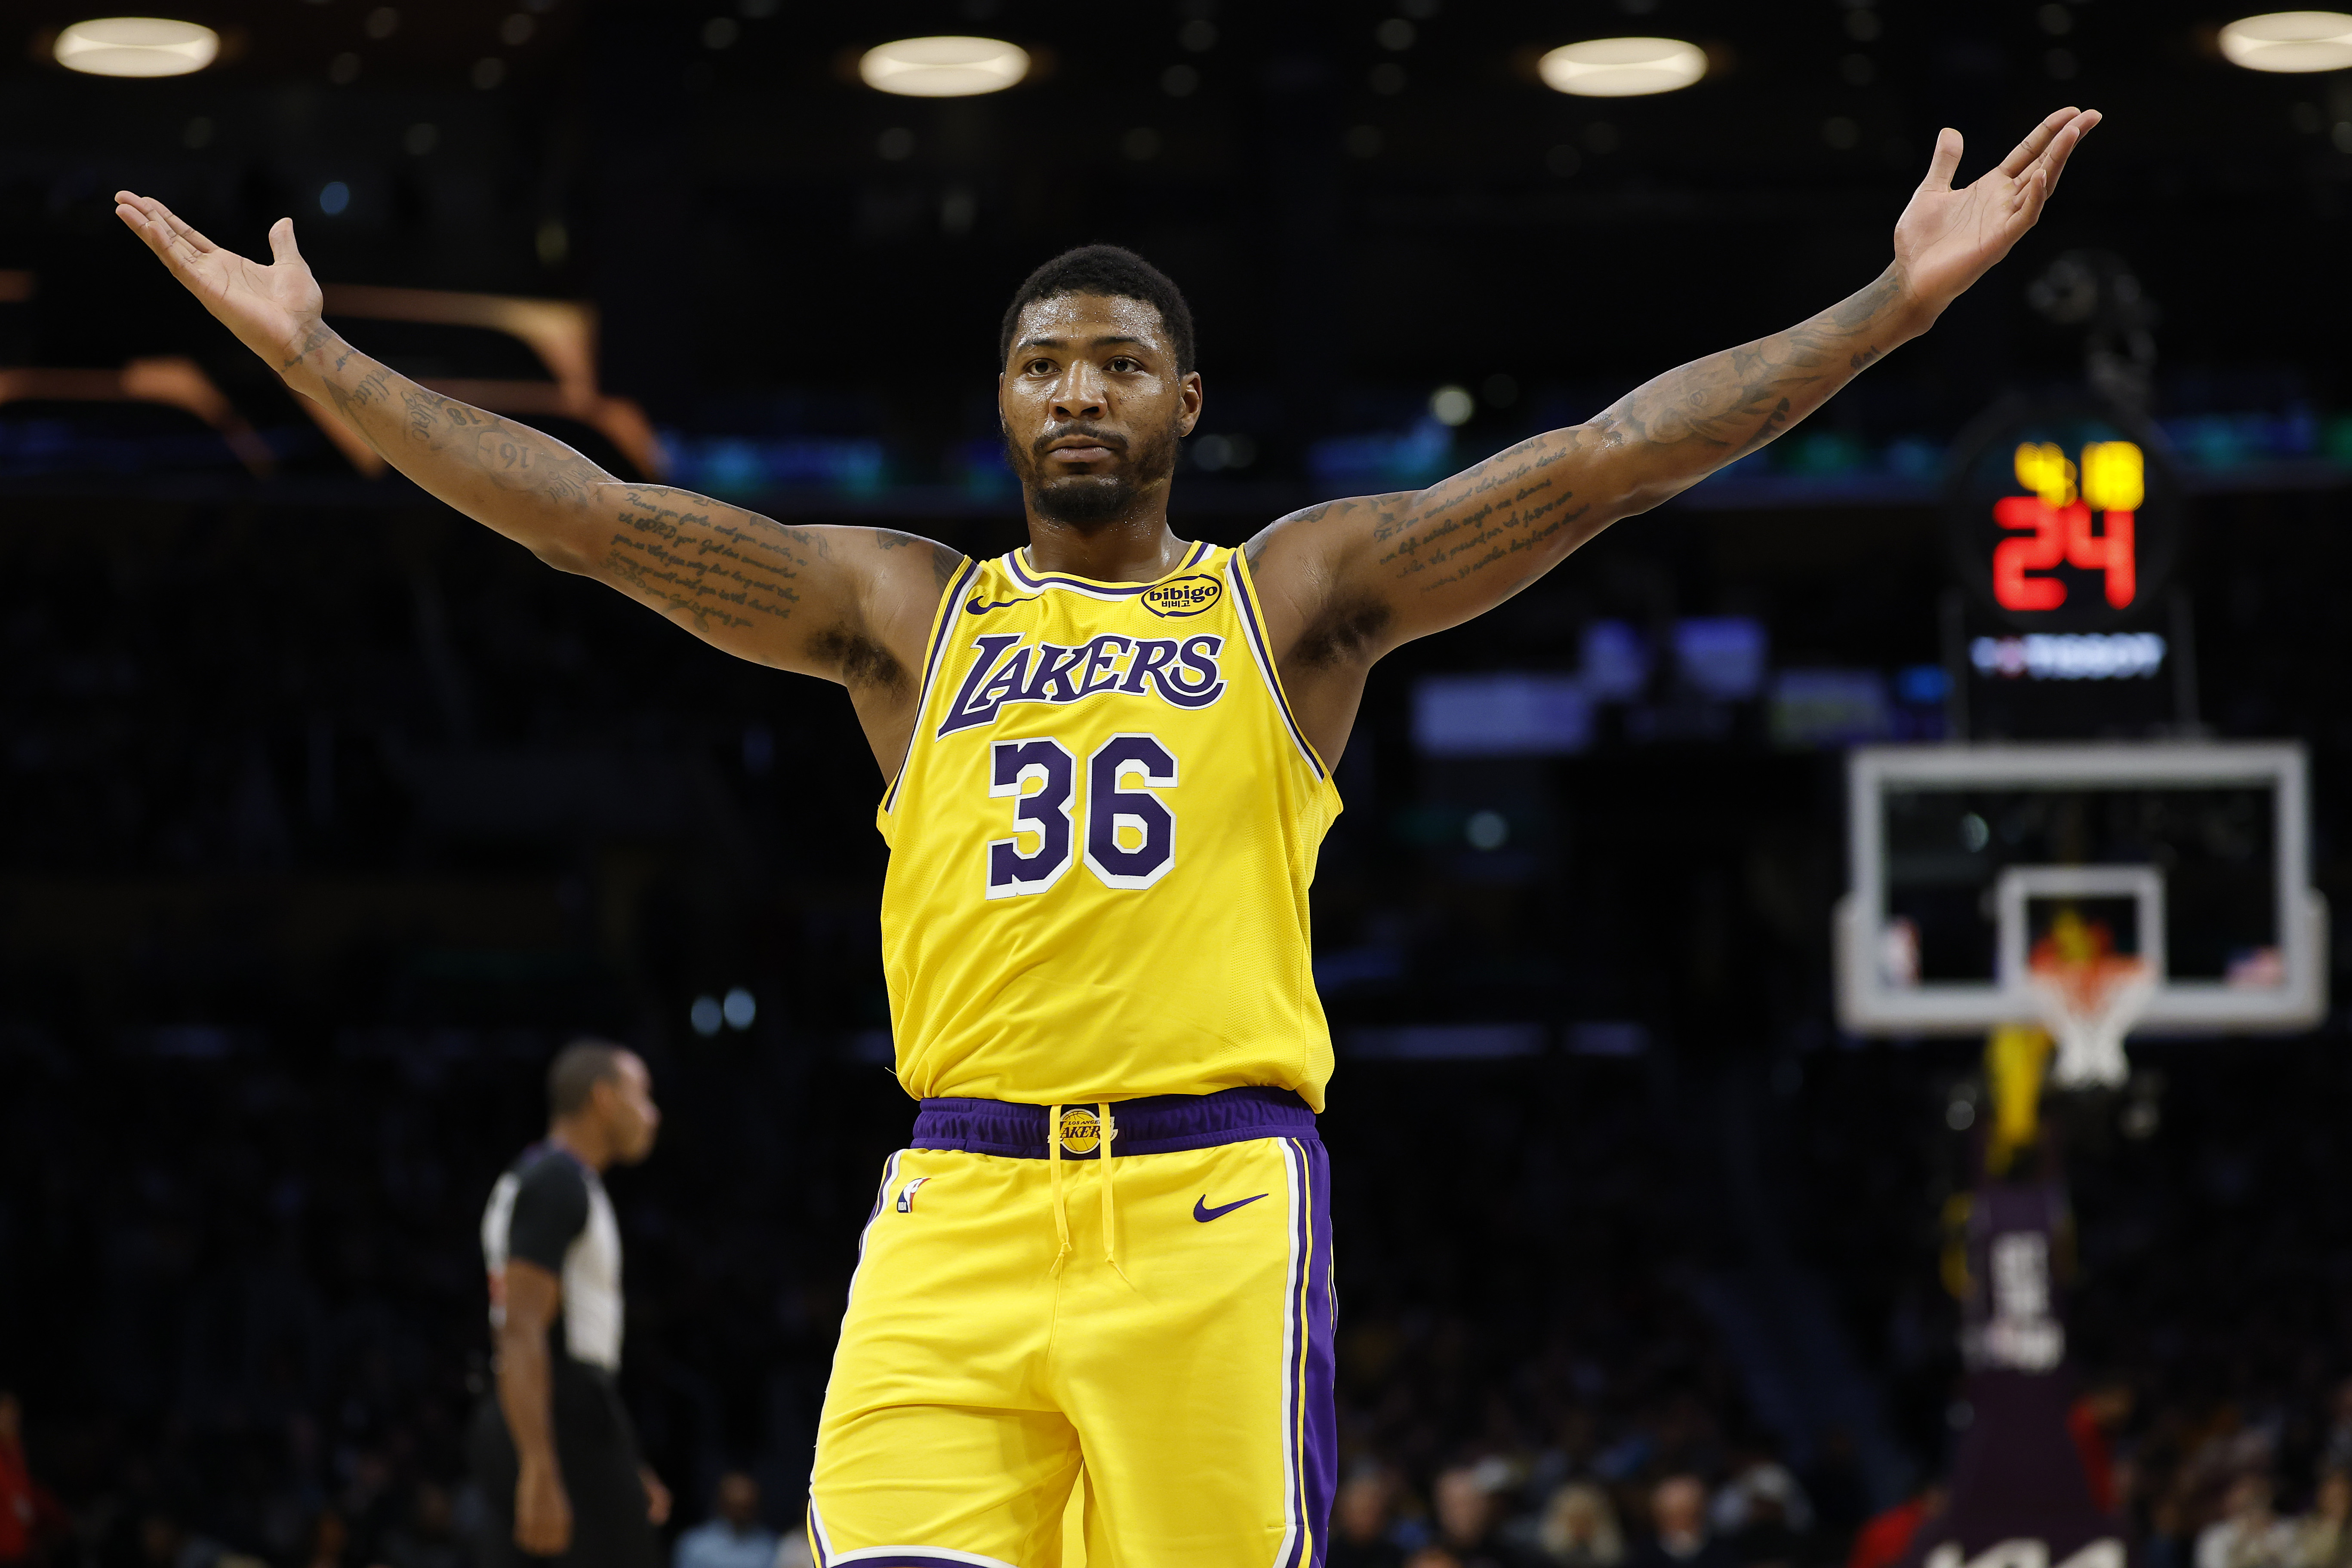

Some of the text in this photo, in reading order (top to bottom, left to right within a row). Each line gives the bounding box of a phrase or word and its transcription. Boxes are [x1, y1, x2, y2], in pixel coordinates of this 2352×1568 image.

[446, 408, 481, 426] 18
[500, 443, 530, 468] 16
[1992, 495, 2136, 611] 24
[1149, 585, 1217, 603] bibigo
[935, 632, 1228, 743] LAKERS
[985, 732, 1179, 900] 36
[1060, 1121, 1111, 1141] AKER
[898, 1202, 907, 1211] NBA
